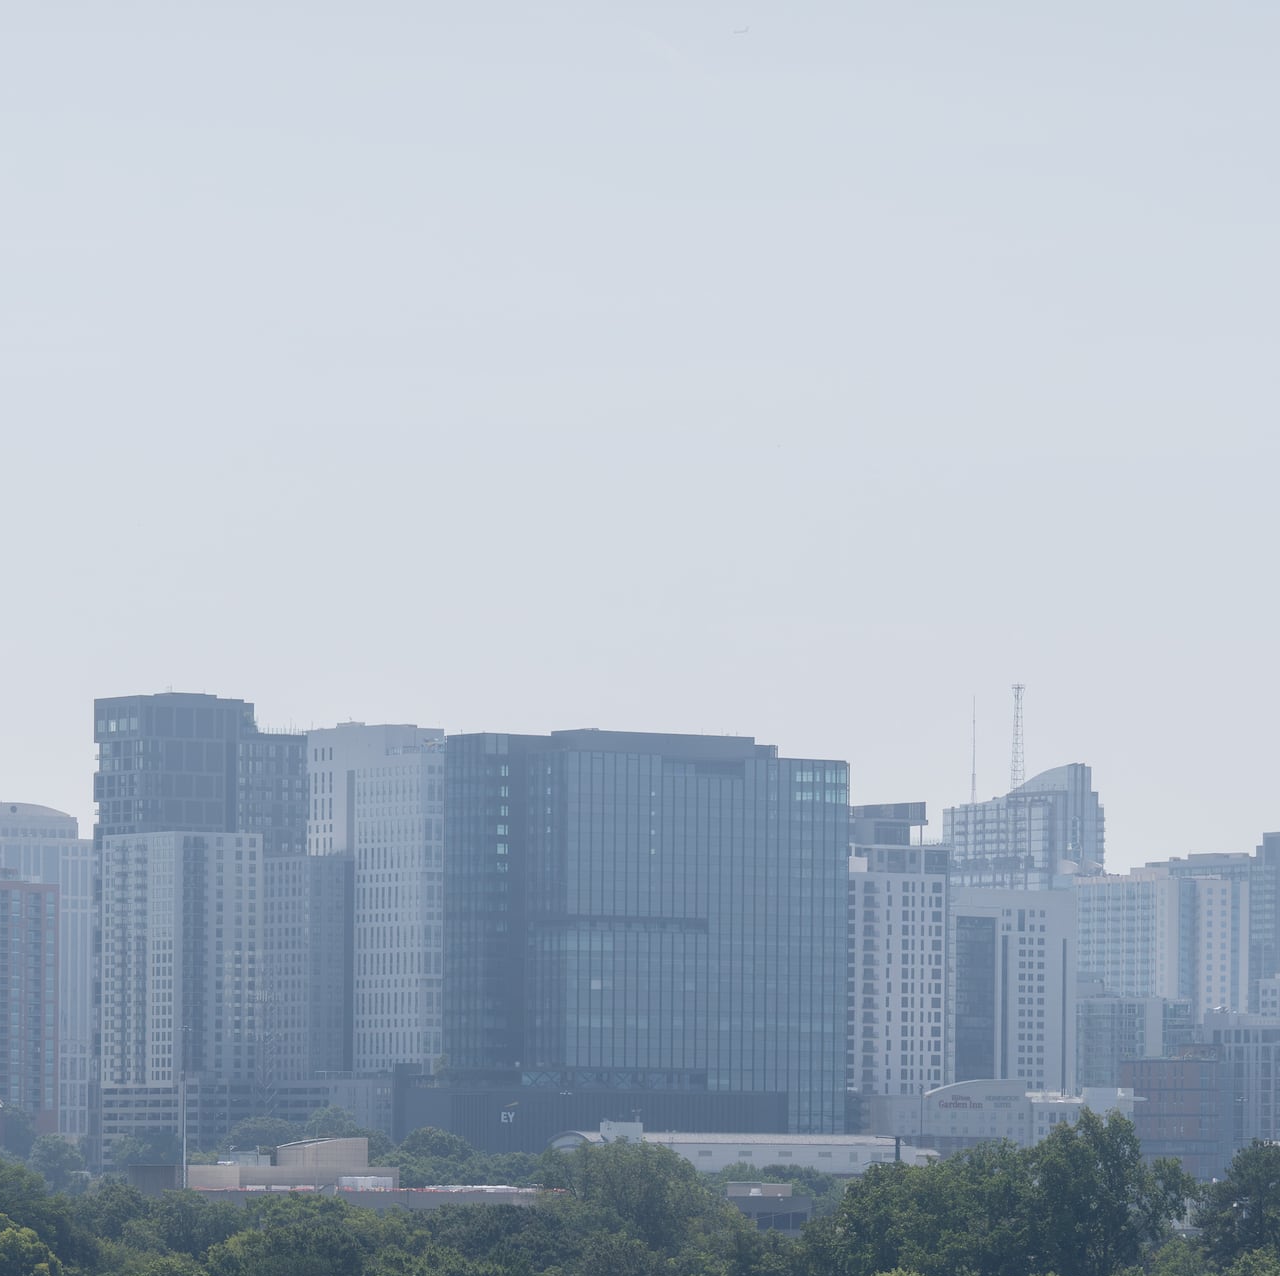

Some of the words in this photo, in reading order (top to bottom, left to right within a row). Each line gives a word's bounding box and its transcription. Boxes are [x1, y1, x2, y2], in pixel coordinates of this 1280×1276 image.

[938, 1100, 968, 1109] Garden
[969, 1100, 983, 1109] Inn
[501, 1111, 515, 1123] EY
